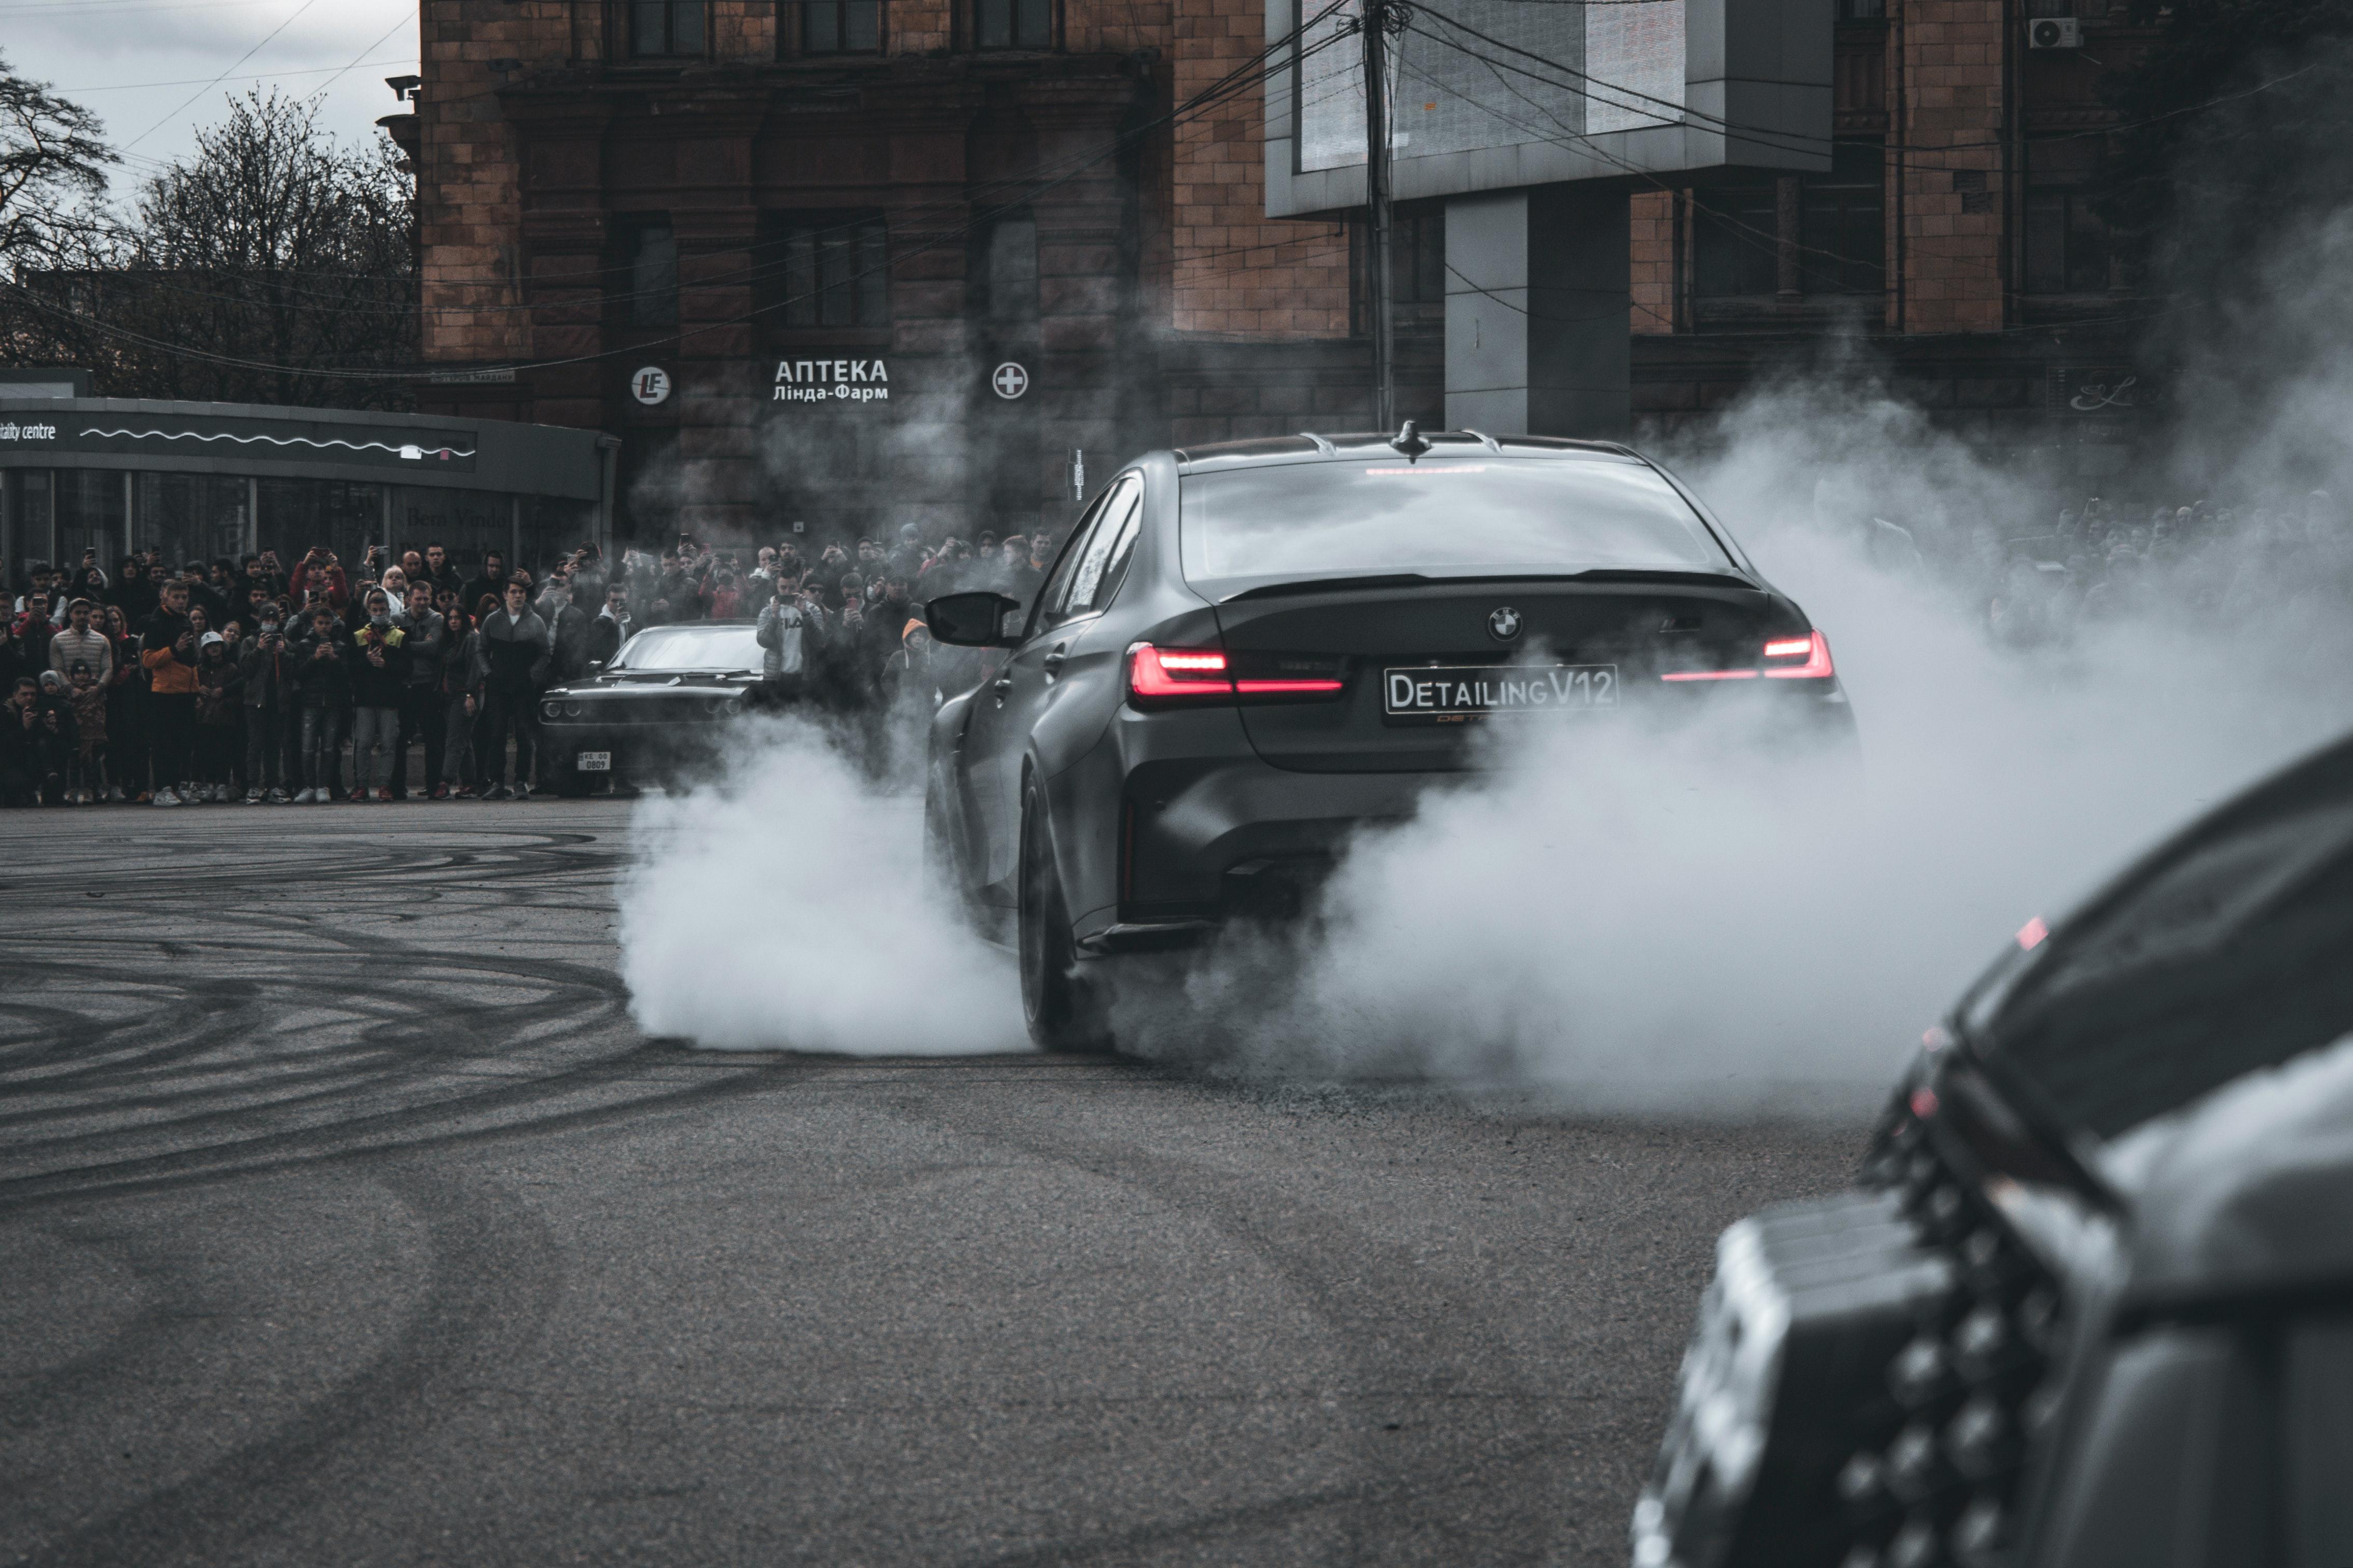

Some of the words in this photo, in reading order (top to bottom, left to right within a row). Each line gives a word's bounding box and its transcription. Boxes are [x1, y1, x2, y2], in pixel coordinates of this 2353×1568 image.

[775, 360, 888, 382] АПТЕКА
[773, 384, 888, 403] Лінда-Фарм
[22, 422, 56, 439] centre
[407, 508, 447, 526] Bem
